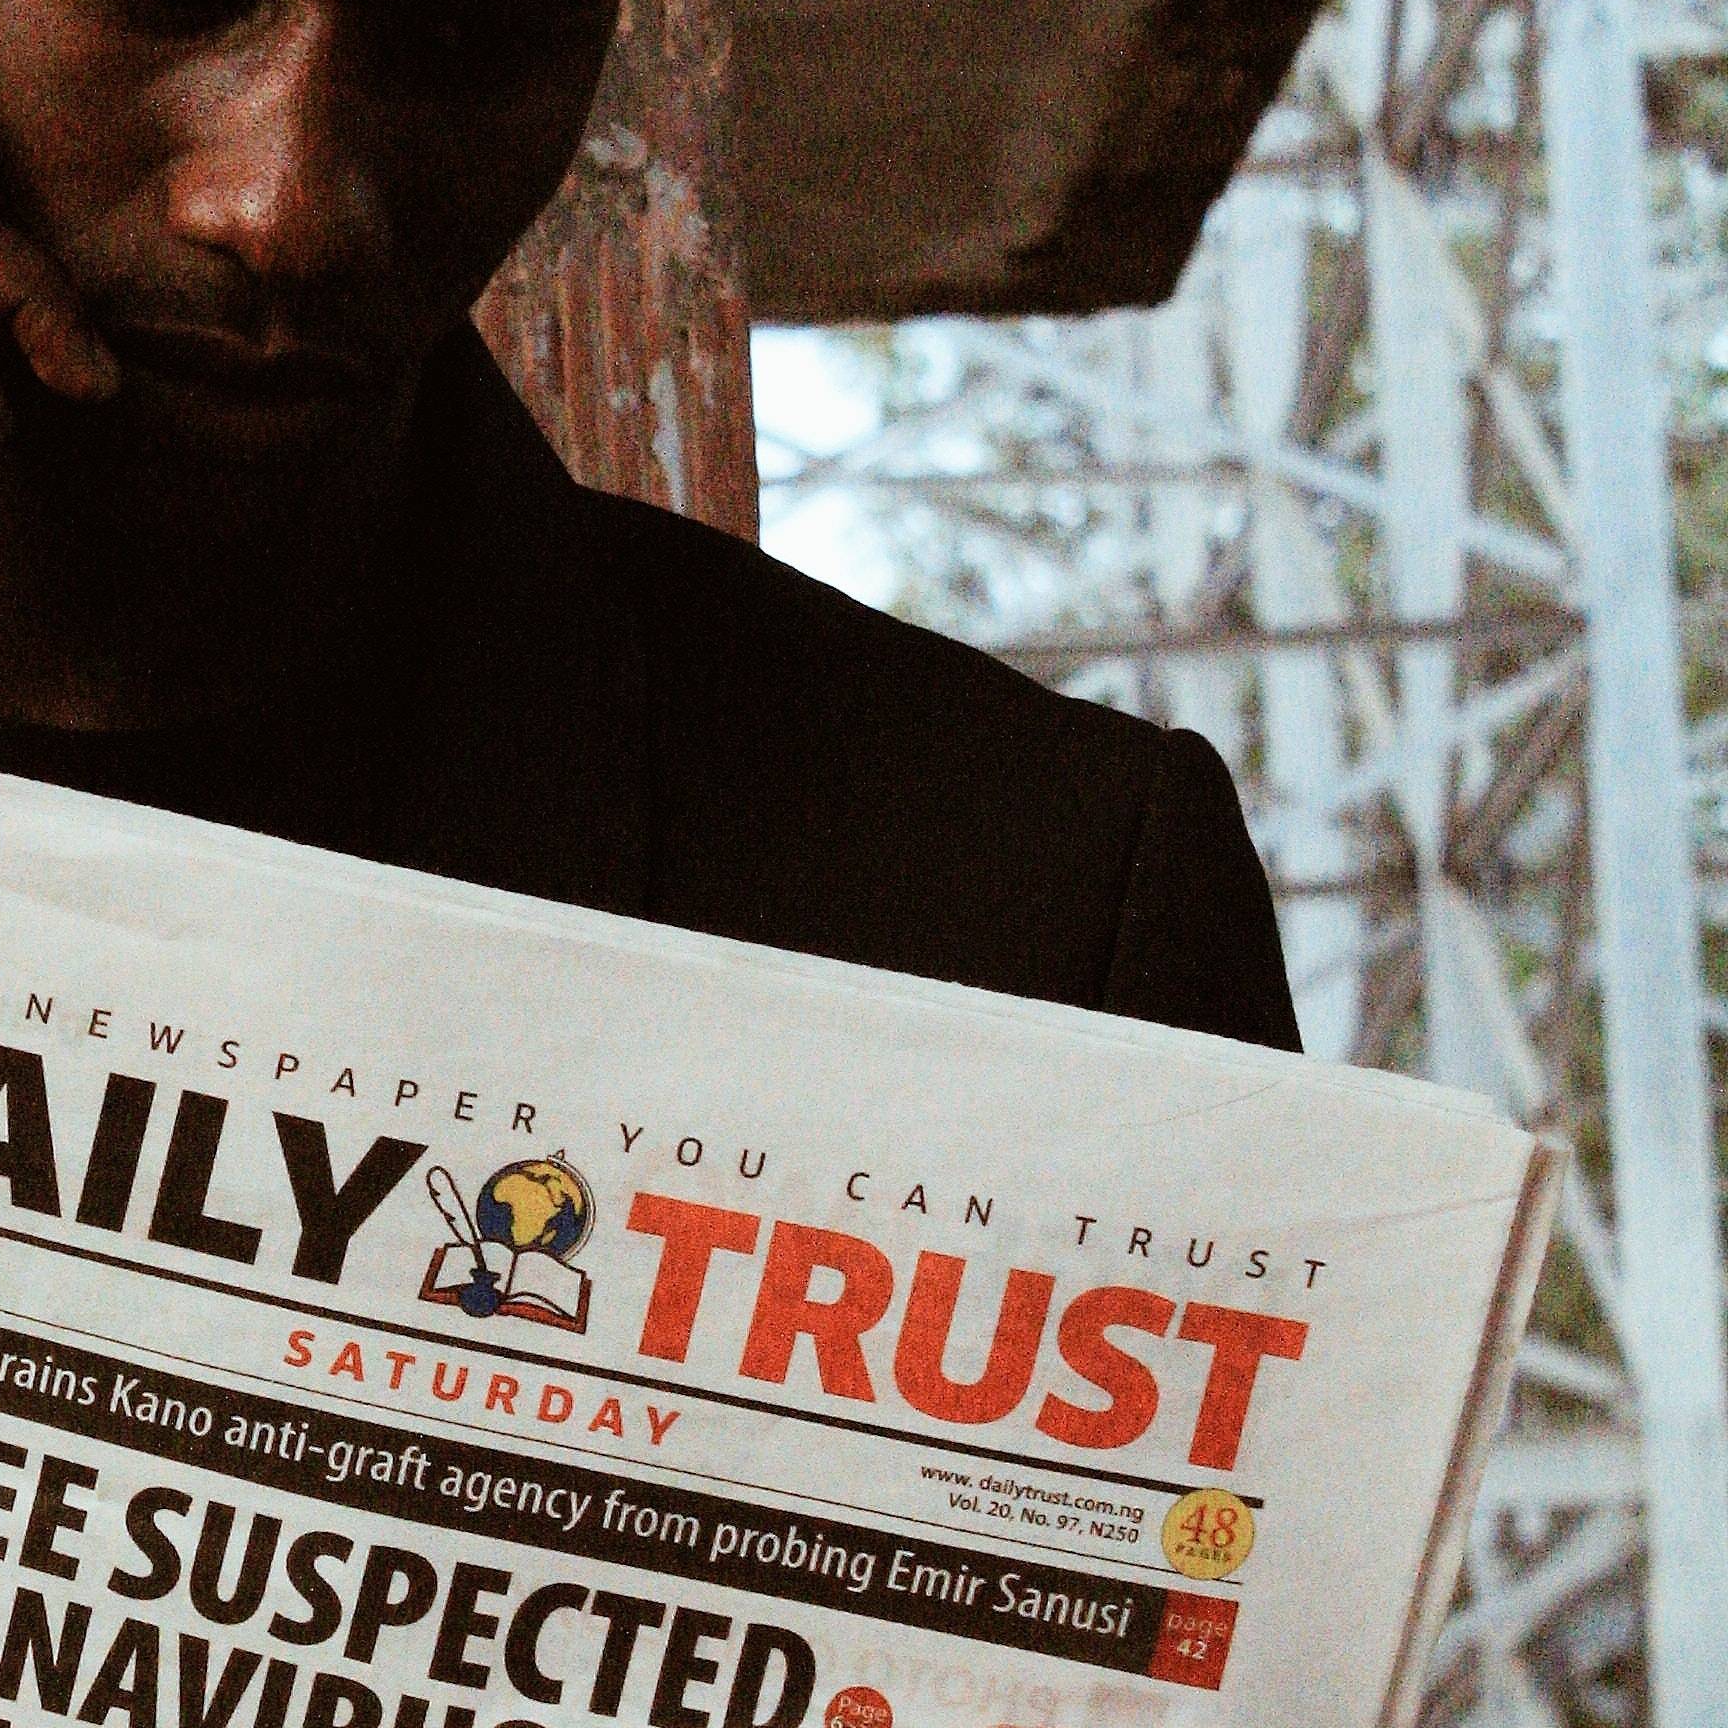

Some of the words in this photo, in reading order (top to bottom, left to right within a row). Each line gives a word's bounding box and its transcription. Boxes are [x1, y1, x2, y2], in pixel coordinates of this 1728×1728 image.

[26, 992, 537, 1133] NEWSPAPER
[619, 1123, 767, 1180] YOU
[846, 1171, 993, 1228] CAN
[1075, 1217, 1327, 1291] TRUST
[626, 1191, 1309, 1471] TRUST
[284, 1330, 684, 1447] SATURDAY
[109, 1373, 212, 1436] Kano
[224, 1410, 431, 1492] anti-graft
[440, 1464, 590, 1534] agency
[602, 1487, 699, 1549] from
[710, 1510, 877, 1594] probing
[887, 1549, 983, 1608] Emir
[991, 1573, 1133, 1640] Sanusi
[949, 1492, 982, 1513] Vol.
[1020, 1507, 1050, 1527] No.
[1180, 1504, 1238, 1548] 48
[1167, 1613, 1228, 1639] page
[1176, 1639, 1208, 1660] 42
[837, 1696, 890, 1722] Page
